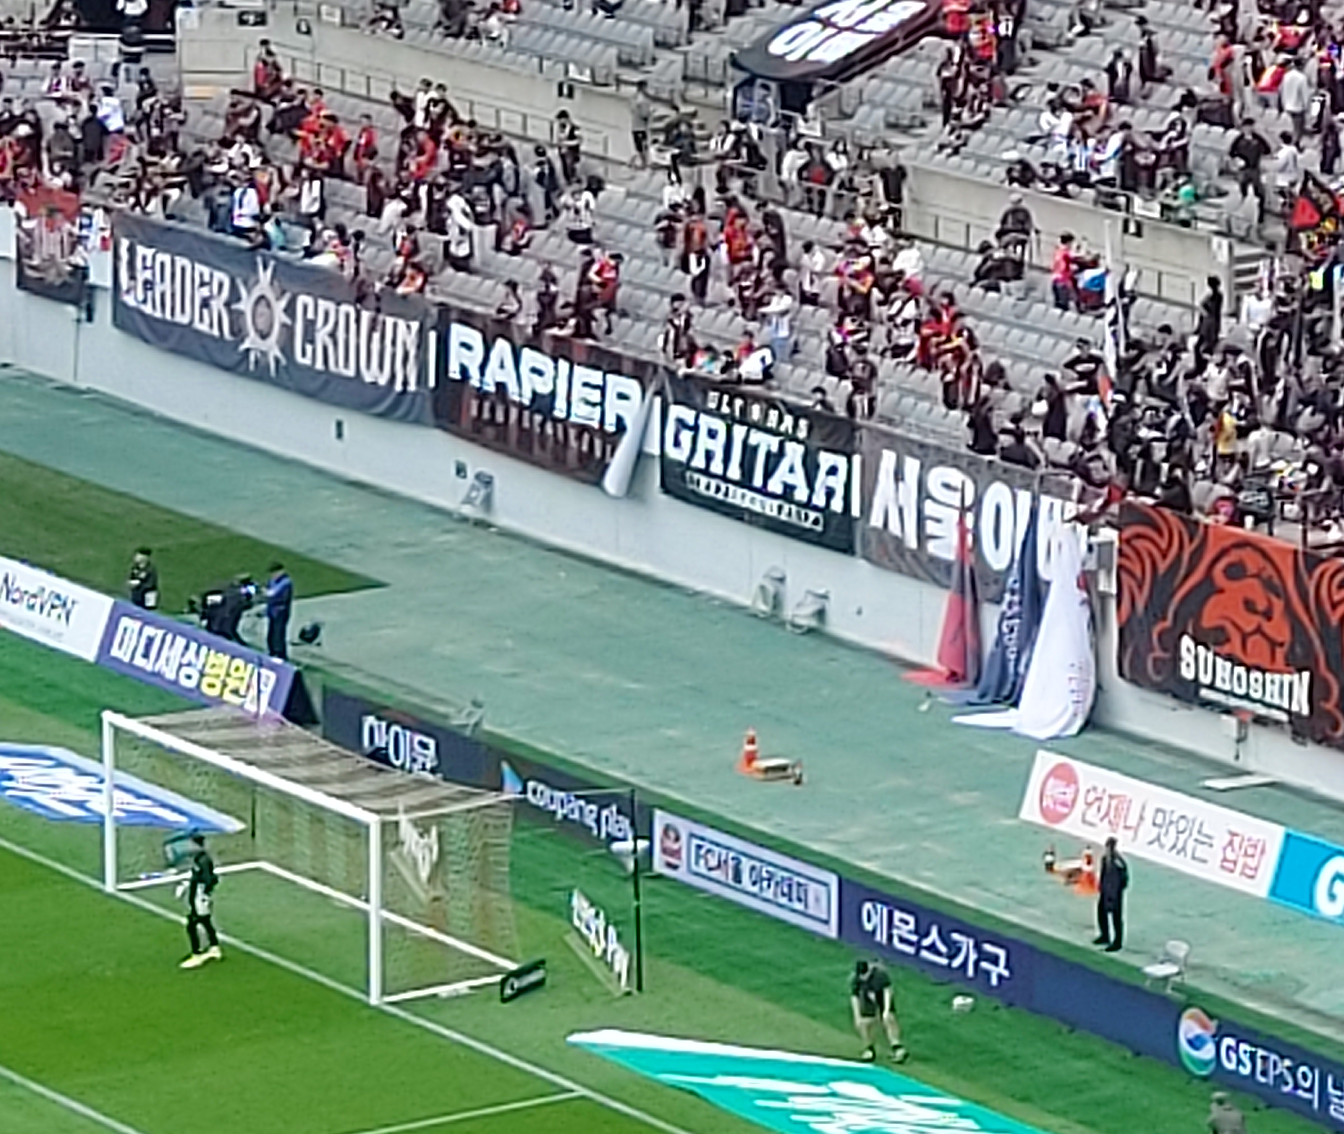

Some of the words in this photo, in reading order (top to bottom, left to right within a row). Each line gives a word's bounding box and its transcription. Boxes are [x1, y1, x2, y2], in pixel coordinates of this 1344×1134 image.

[120, 238, 235, 341] LEADER
[294, 295, 420, 393] CROWN
[448, 323, 641, 433] RAPIER
[665, 403, 849, 514] GRITAR
[1, 571, 76, 628] NordVPN
[1180, 635, 1311, 716] SUHOSHIN
[527, 780, 598, 837] coupang
[1081, 784, 1148, 844] 언제나
[1147, 806, 1215, 865] 맛있는
[1219, 829, 1268, 880] 집밥
[861, 901, 1010, 987] 에몬스가구
